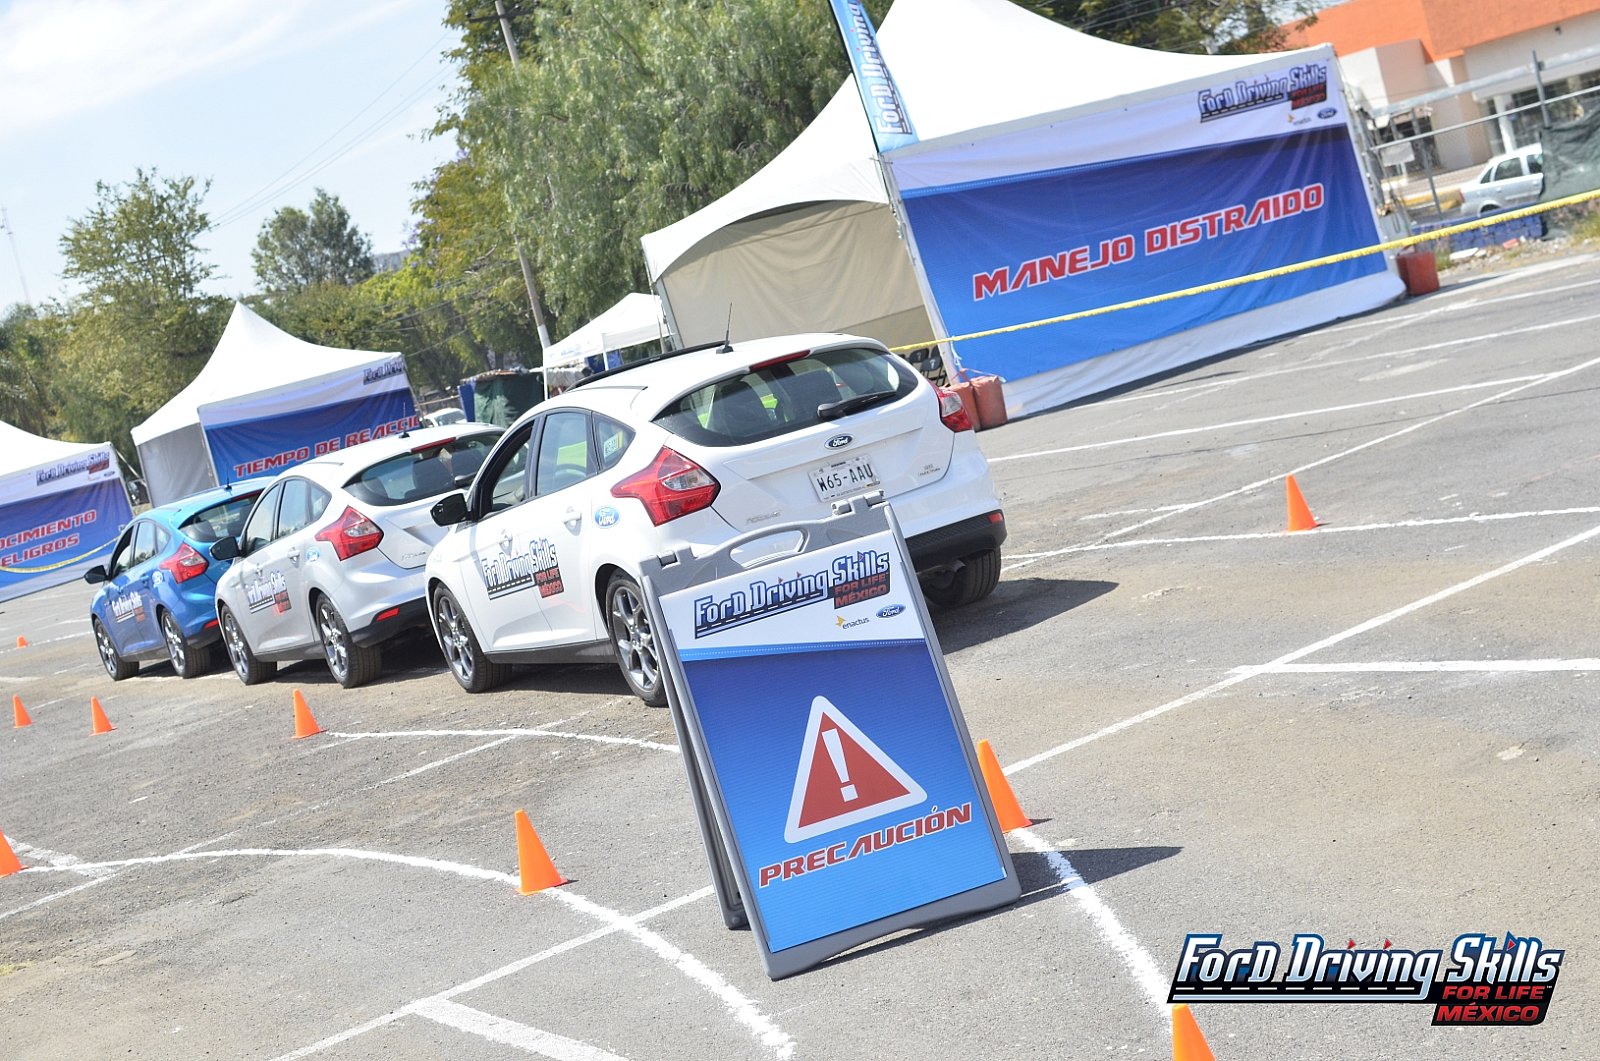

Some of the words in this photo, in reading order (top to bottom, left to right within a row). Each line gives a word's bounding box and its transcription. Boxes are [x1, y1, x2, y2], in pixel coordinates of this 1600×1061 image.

[1235, 76, 1288, 105] Driving
[1288, 64, 1327, 90] Skills
[973, 235, 1135, 301] MANEJO
[1145, 182, 1324, 256] DISTRAIDO
[233, 446, 310, 478] TIEMPO
[315, 437, 341, 457] DE
[816, 463, 874, 492] W65-AAU
[597, 508, 616, 526] Ford
[529, 538, 558, 573] Skills
[749, 570, 829, 612] Driving
[831, 550, 889, 587] Skills
[834, 581, 859, 594] FOR
[835, 584, 887, 607] MÉXICO
[842, 617, 870, 630] enactus
[759, 802, 972, 888] PRECAUCIÓN
